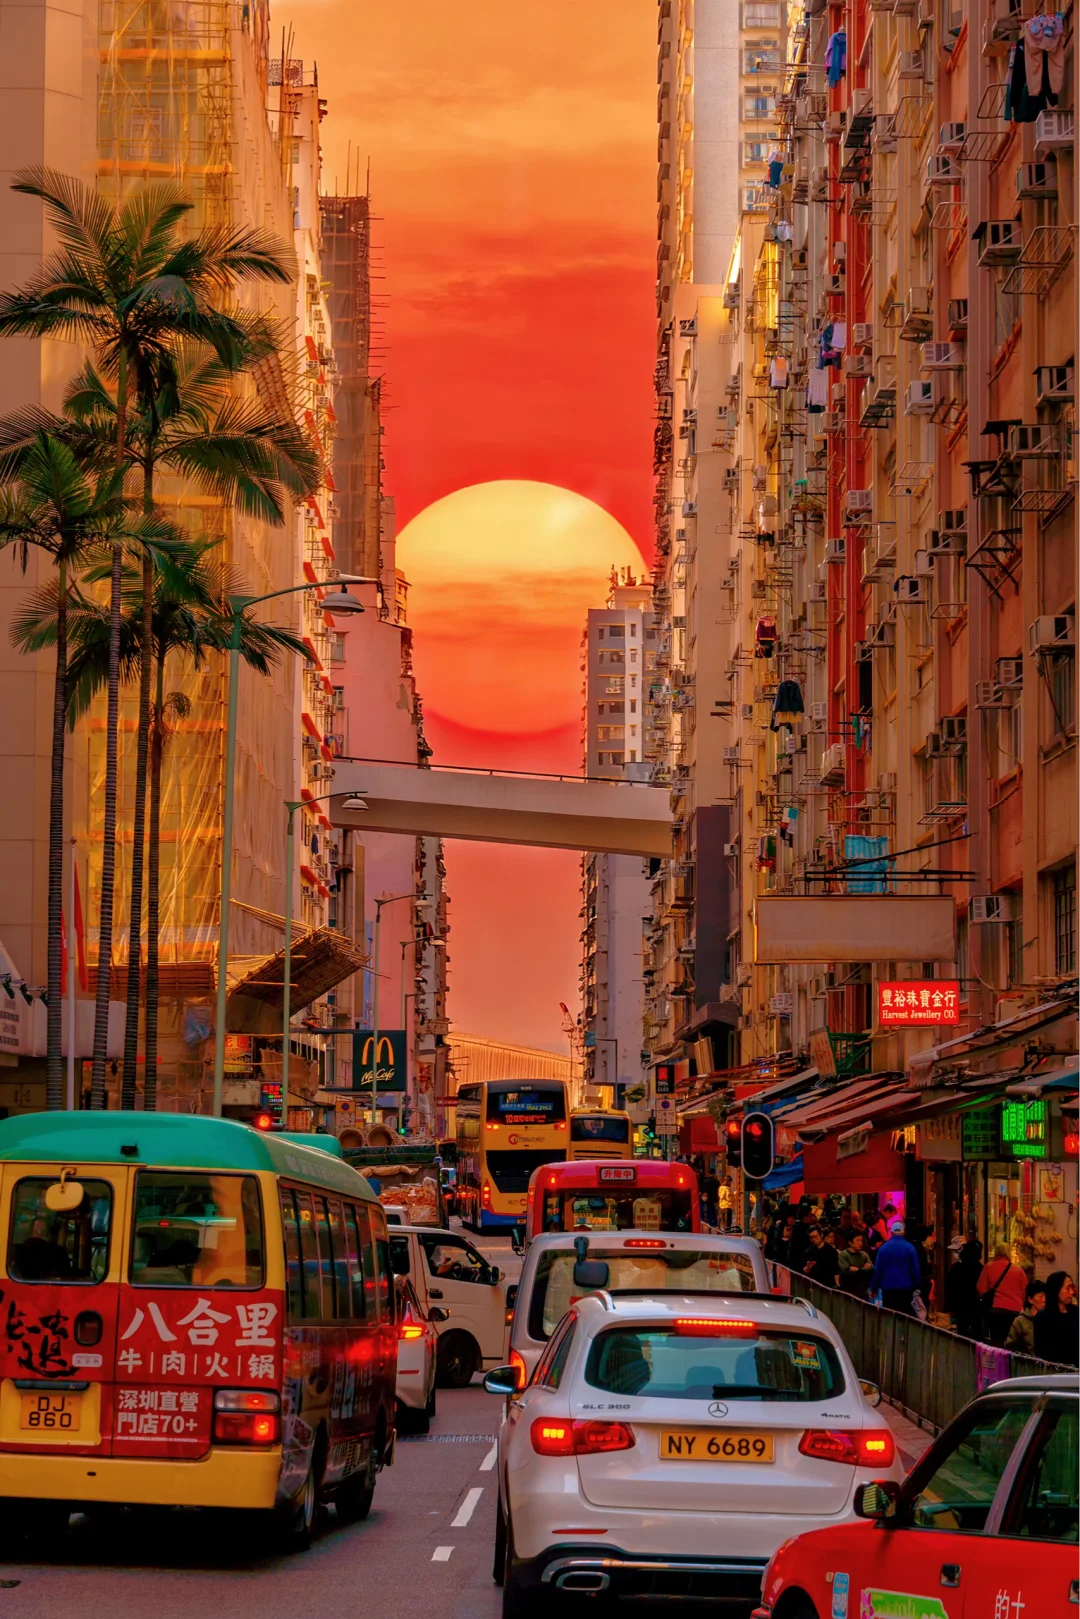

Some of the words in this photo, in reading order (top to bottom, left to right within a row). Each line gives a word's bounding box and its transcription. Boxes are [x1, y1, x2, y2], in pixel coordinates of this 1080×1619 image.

[882, 1010, 909, 1019] Harvest
[911, 1010, 942, 1020] Jewellery
[120, 1297, 278, 1348] 八合里
[37, 1396, 66, 1412] DJ
[118, 1389, 199, 1413] 深圳直營
[582, 1403, 605, 1411] GLC
[607, 1403, 631, 1411] 300
[28, 1411, 73, 1428] 860
[117, 1412, 199, 1435] 門店70+
[667, 1435, 697, 1455] NY
[706, 1436, 767, 1458] 6689
